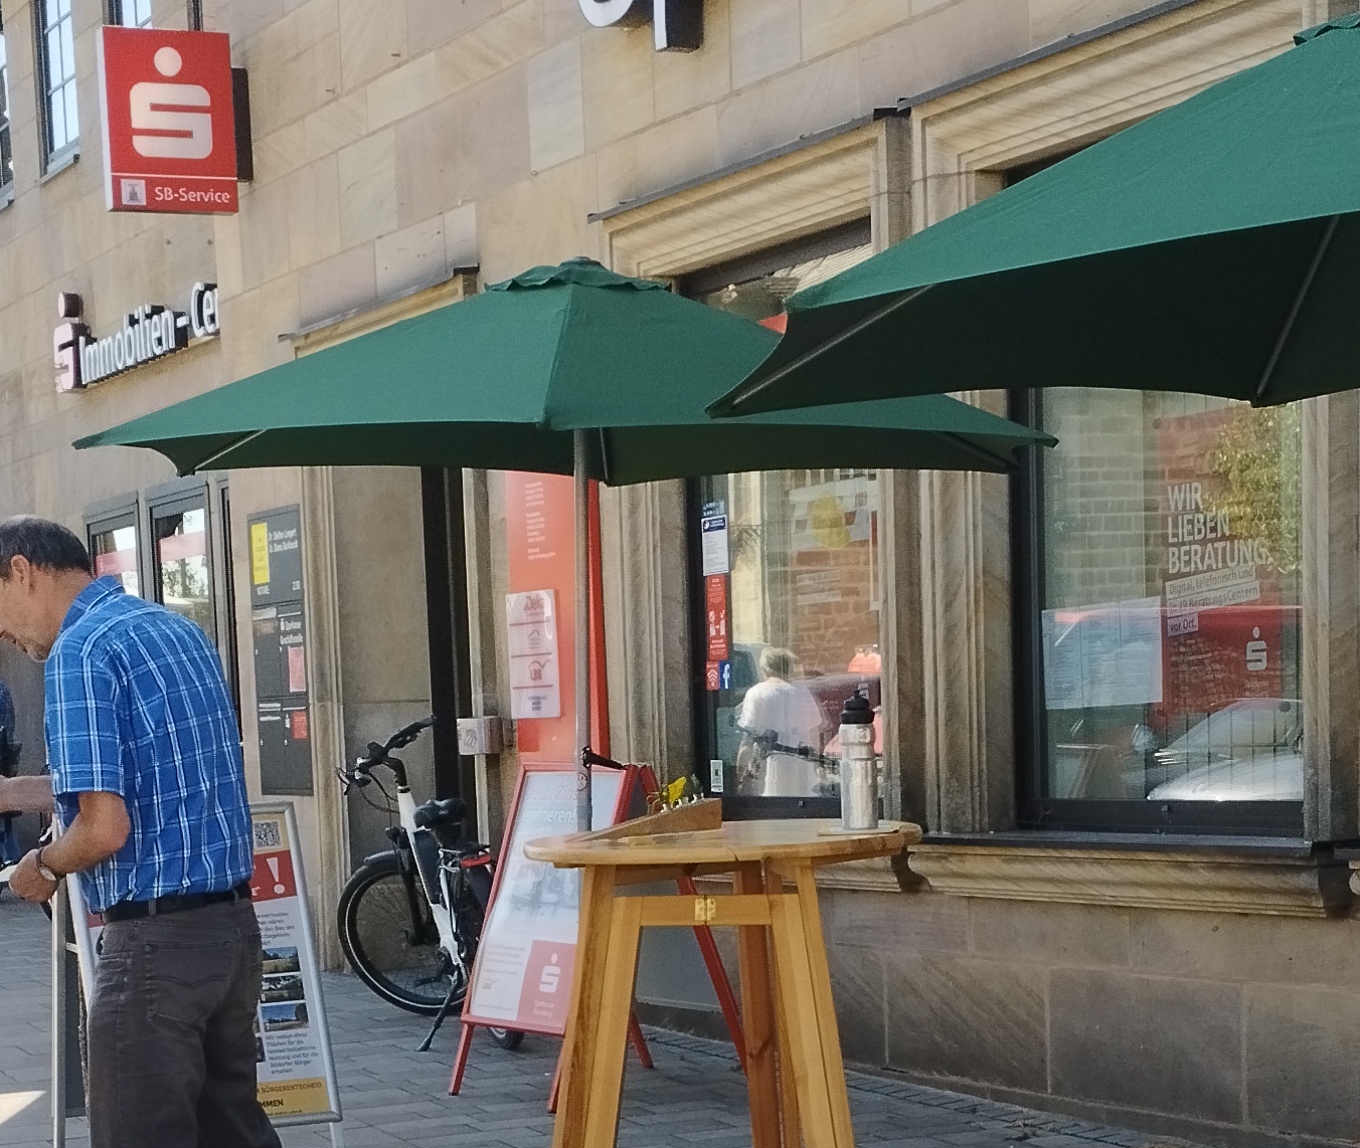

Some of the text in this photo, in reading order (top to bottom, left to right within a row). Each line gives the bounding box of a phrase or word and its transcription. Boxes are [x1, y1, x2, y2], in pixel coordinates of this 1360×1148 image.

[154, 186, 230, 203] SB-Service
[1167, 482, 1202, 512] WIR
[1168, 511, 1230, 543] LIEBEN
[1196, 570, 1237, 588] telefonisch
[1238, 564, 1254, 579] und
[1183, 618, 1197, 630] Ort.
